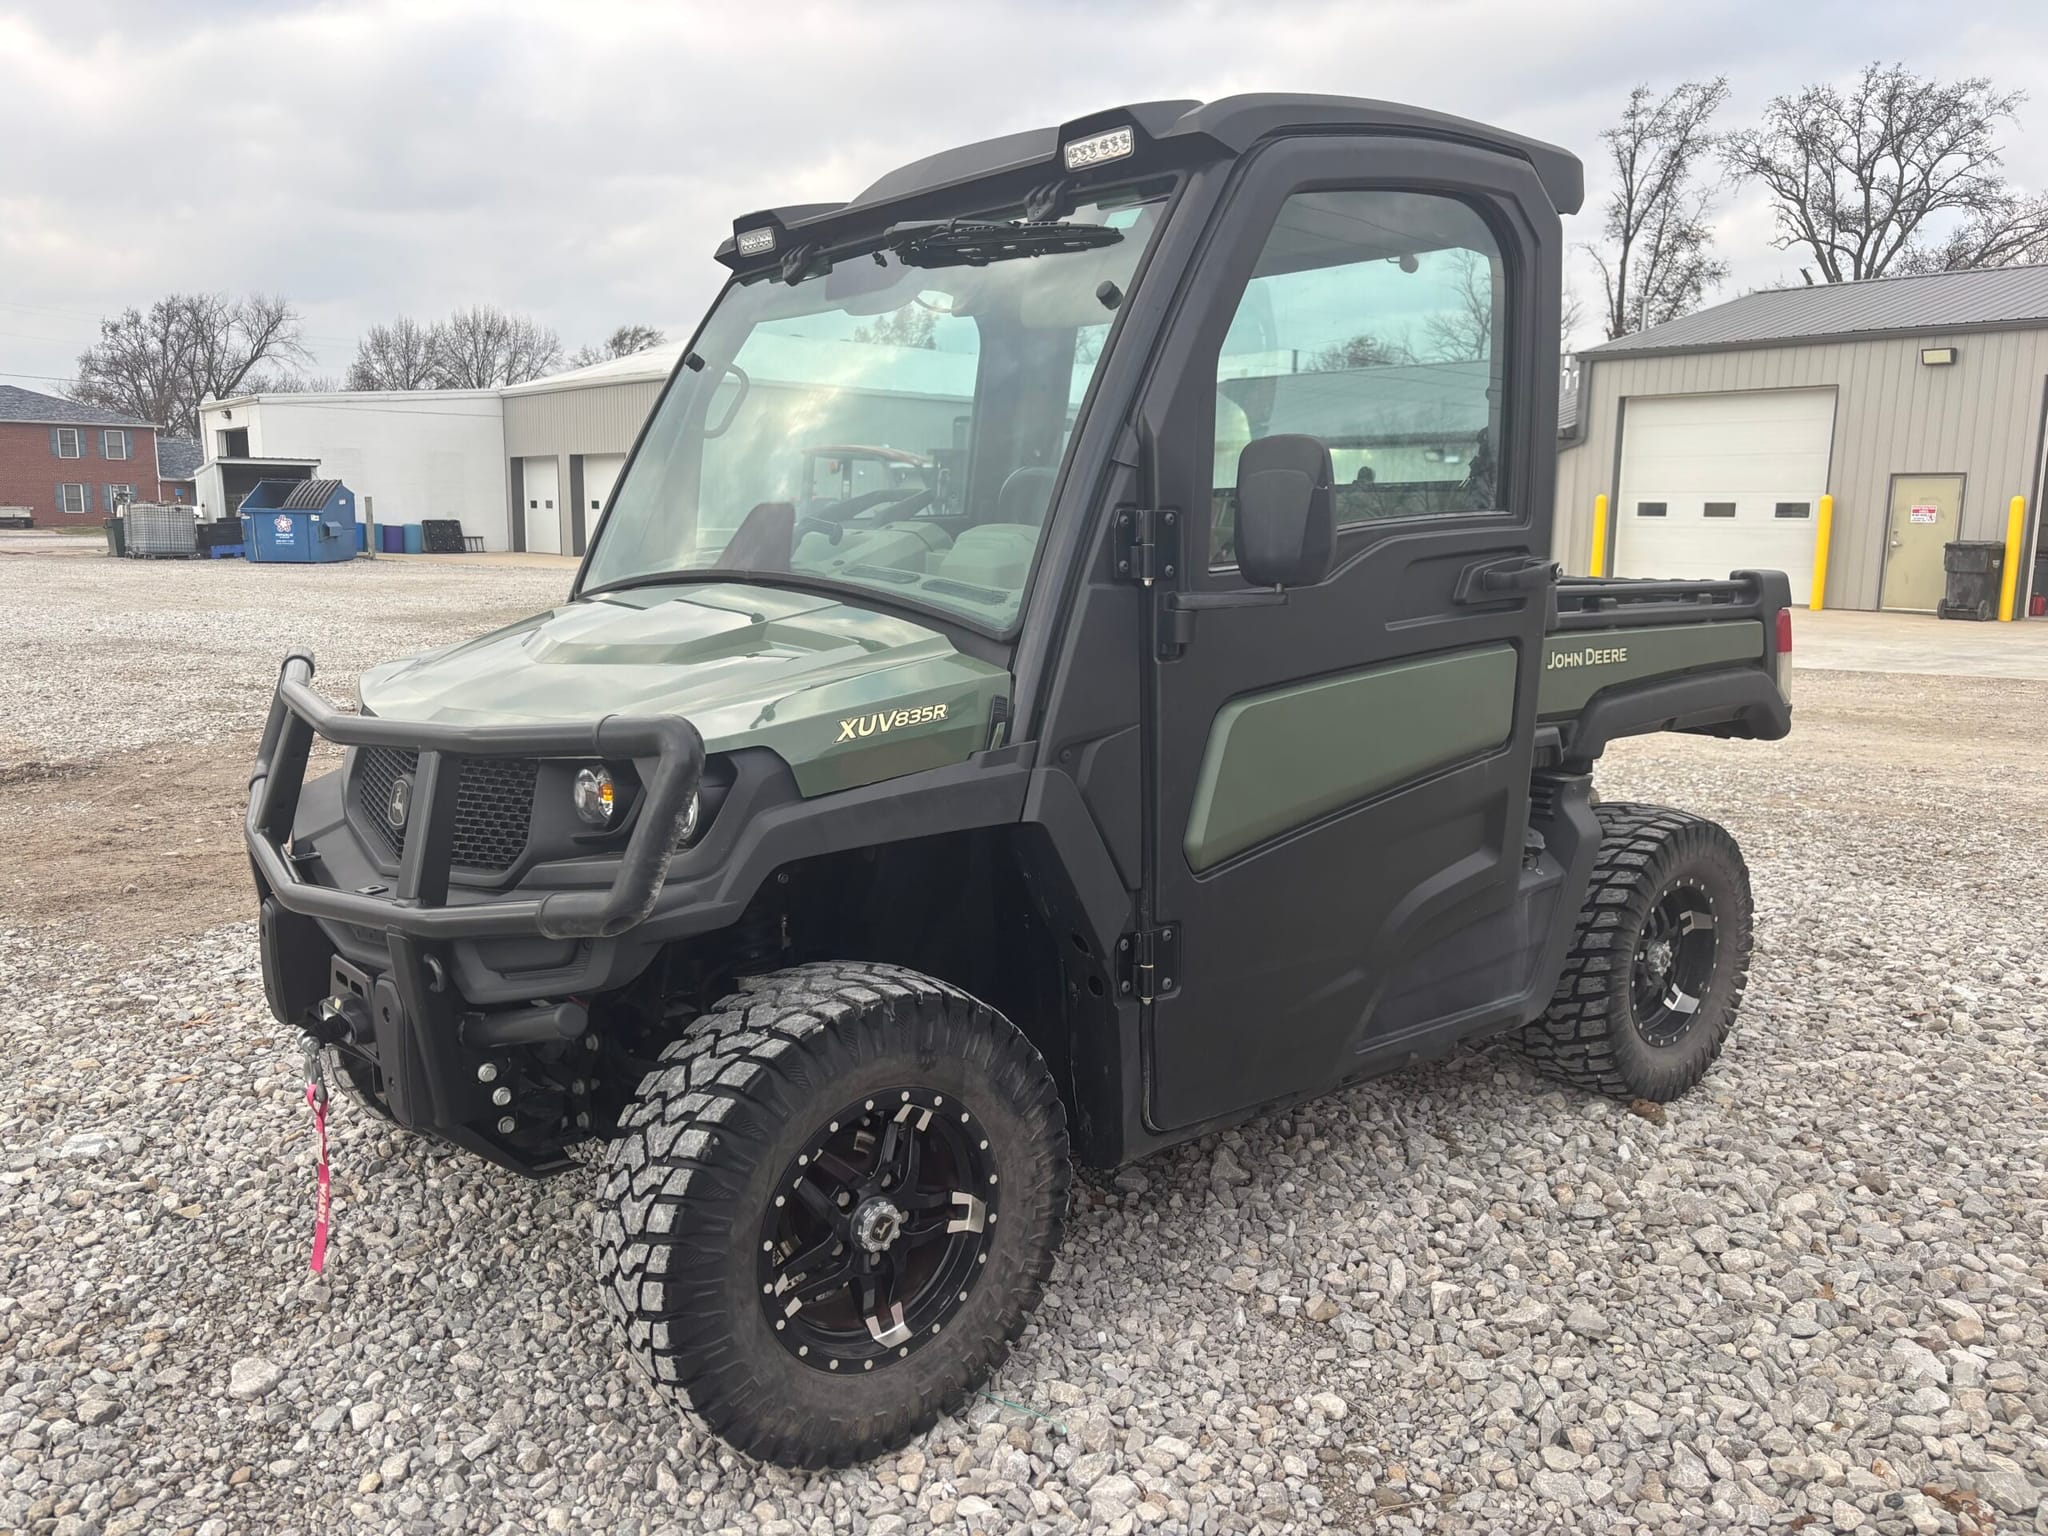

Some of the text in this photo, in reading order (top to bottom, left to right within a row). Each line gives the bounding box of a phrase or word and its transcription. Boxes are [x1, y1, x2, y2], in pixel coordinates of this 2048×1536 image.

[1547, 647, 1628, 669] JOHN DEERE
[836, 703, 948, 742] XUV835R
[317, 1182, 328, 1224] WARN
